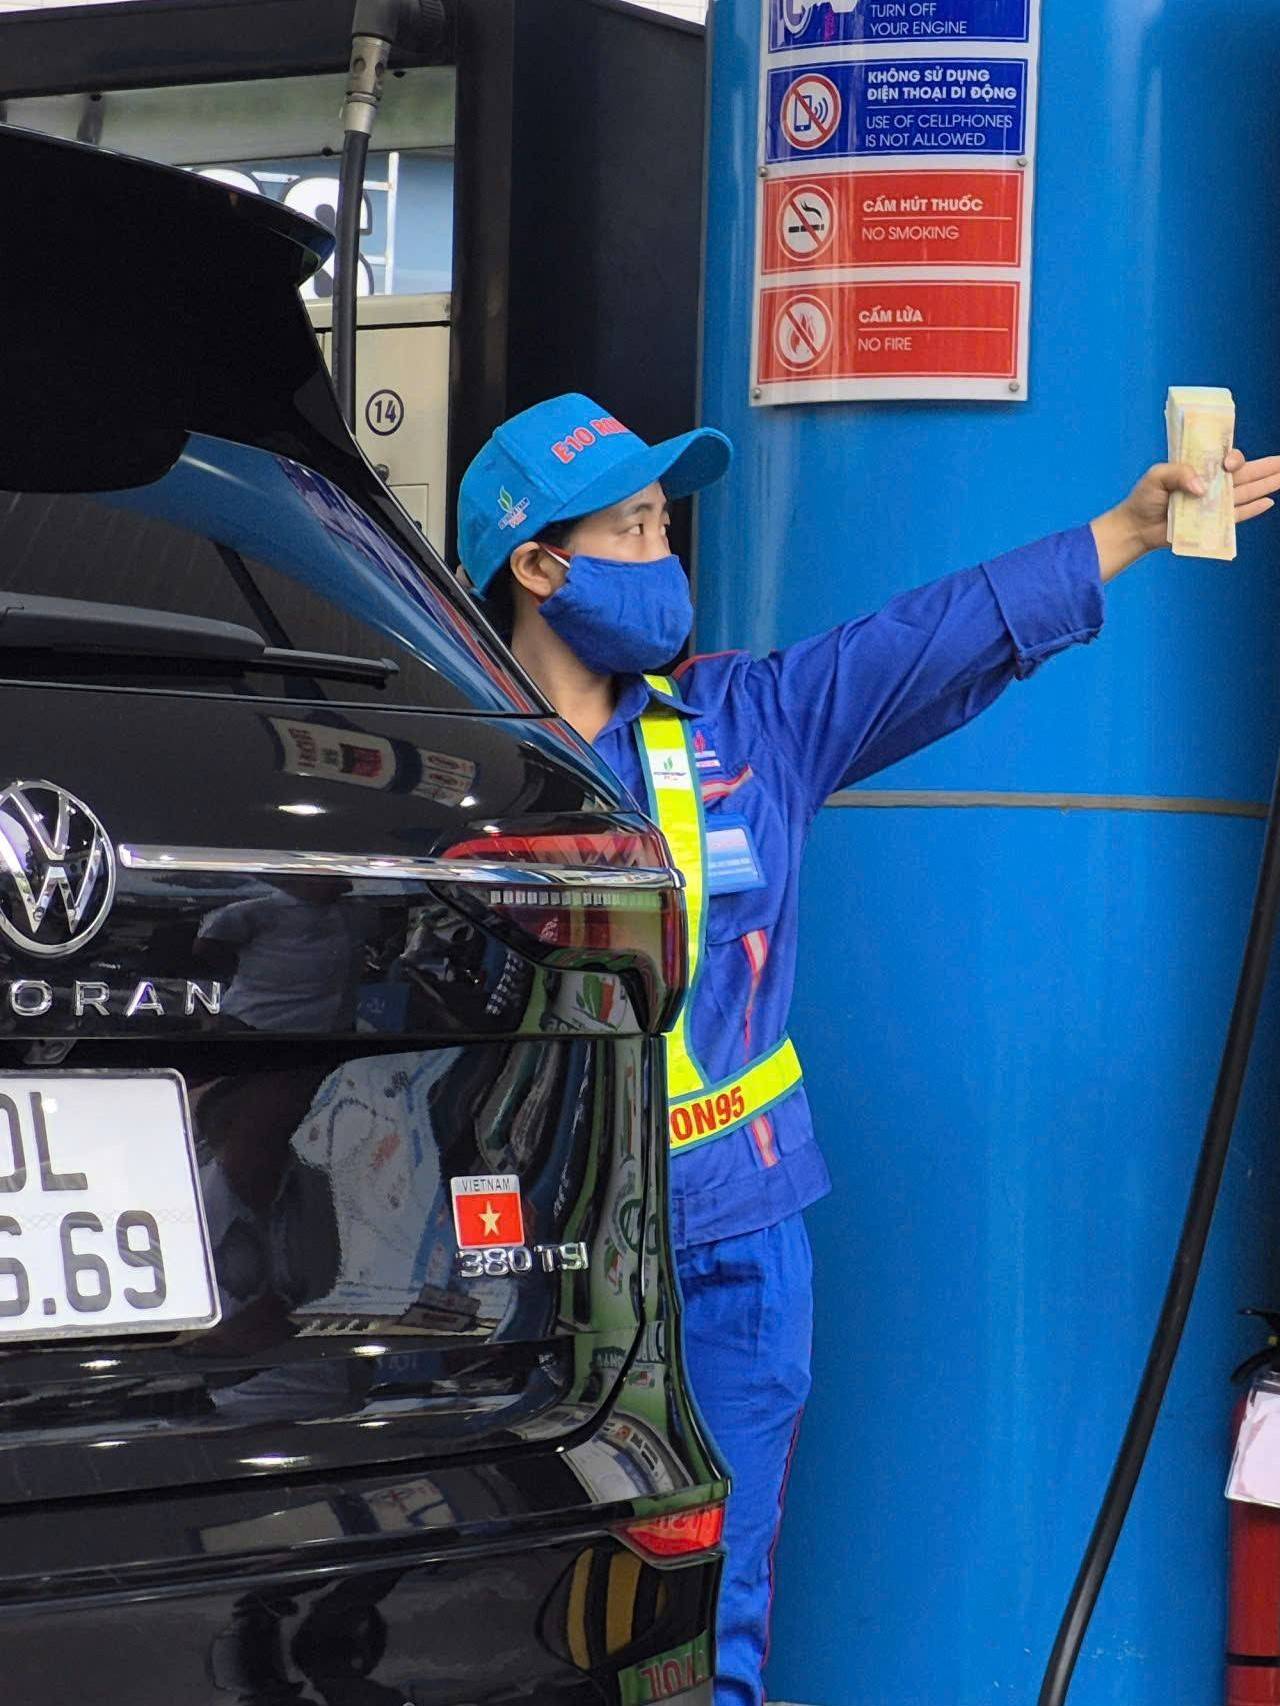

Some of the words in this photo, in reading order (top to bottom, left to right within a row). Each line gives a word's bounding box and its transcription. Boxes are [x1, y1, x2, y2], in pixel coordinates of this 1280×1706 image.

[870, 4, 906, 18] TURN
[909, 3, 937, 17] OFF
[870, 22, 909, 36] YOUR
[912, 21, 968, 35] ENGINE
[867, 67, 921, 83] KHÔNG
[924, 65, 944, 82] SỬ
[946, 69, 990, 85] DỤNG
[867, 85, 899, 103] ĐIỆN
[903, 87, 947, 102] THOẠI
[950, 87, 967, 99] DI
[970, 84, 1017, 102] ĐỘNG
[866, 115, 890, 129] USE
[893, 114, 915, 128] OF
[918, 114, 1013, 128] CELLPHONES
[865, 134, 877, 147] IS
[879, 133, 910, 146] NOT
[912, 132, 986, 146] ALLOWED
[863, 195, 897, 212] CẤM
[900, 195, 929, 212] HÚT
[931, 194, 983, 211] THUỐC
[862, 227, 886, 240] NO
[888, 225, 960, 240] SMOKING
[858, 305, 893, 323] CẤM
[896, 305, 924, 323] LỬA
[858, 337, 881, 352] NO
[885, 336, 912, 351] FIRE
[374, 400, 397, 423] 14
[551, 427, 596, 464] E10
[11, 979, 221, 1017] ORAN
[671, 1086, 745, 1145] ON95
[461, 1179, 511, 1192] VIETNAM
[455, 1246, 533, 1278] 380
[533, 1241, 589, 1273] TSI
